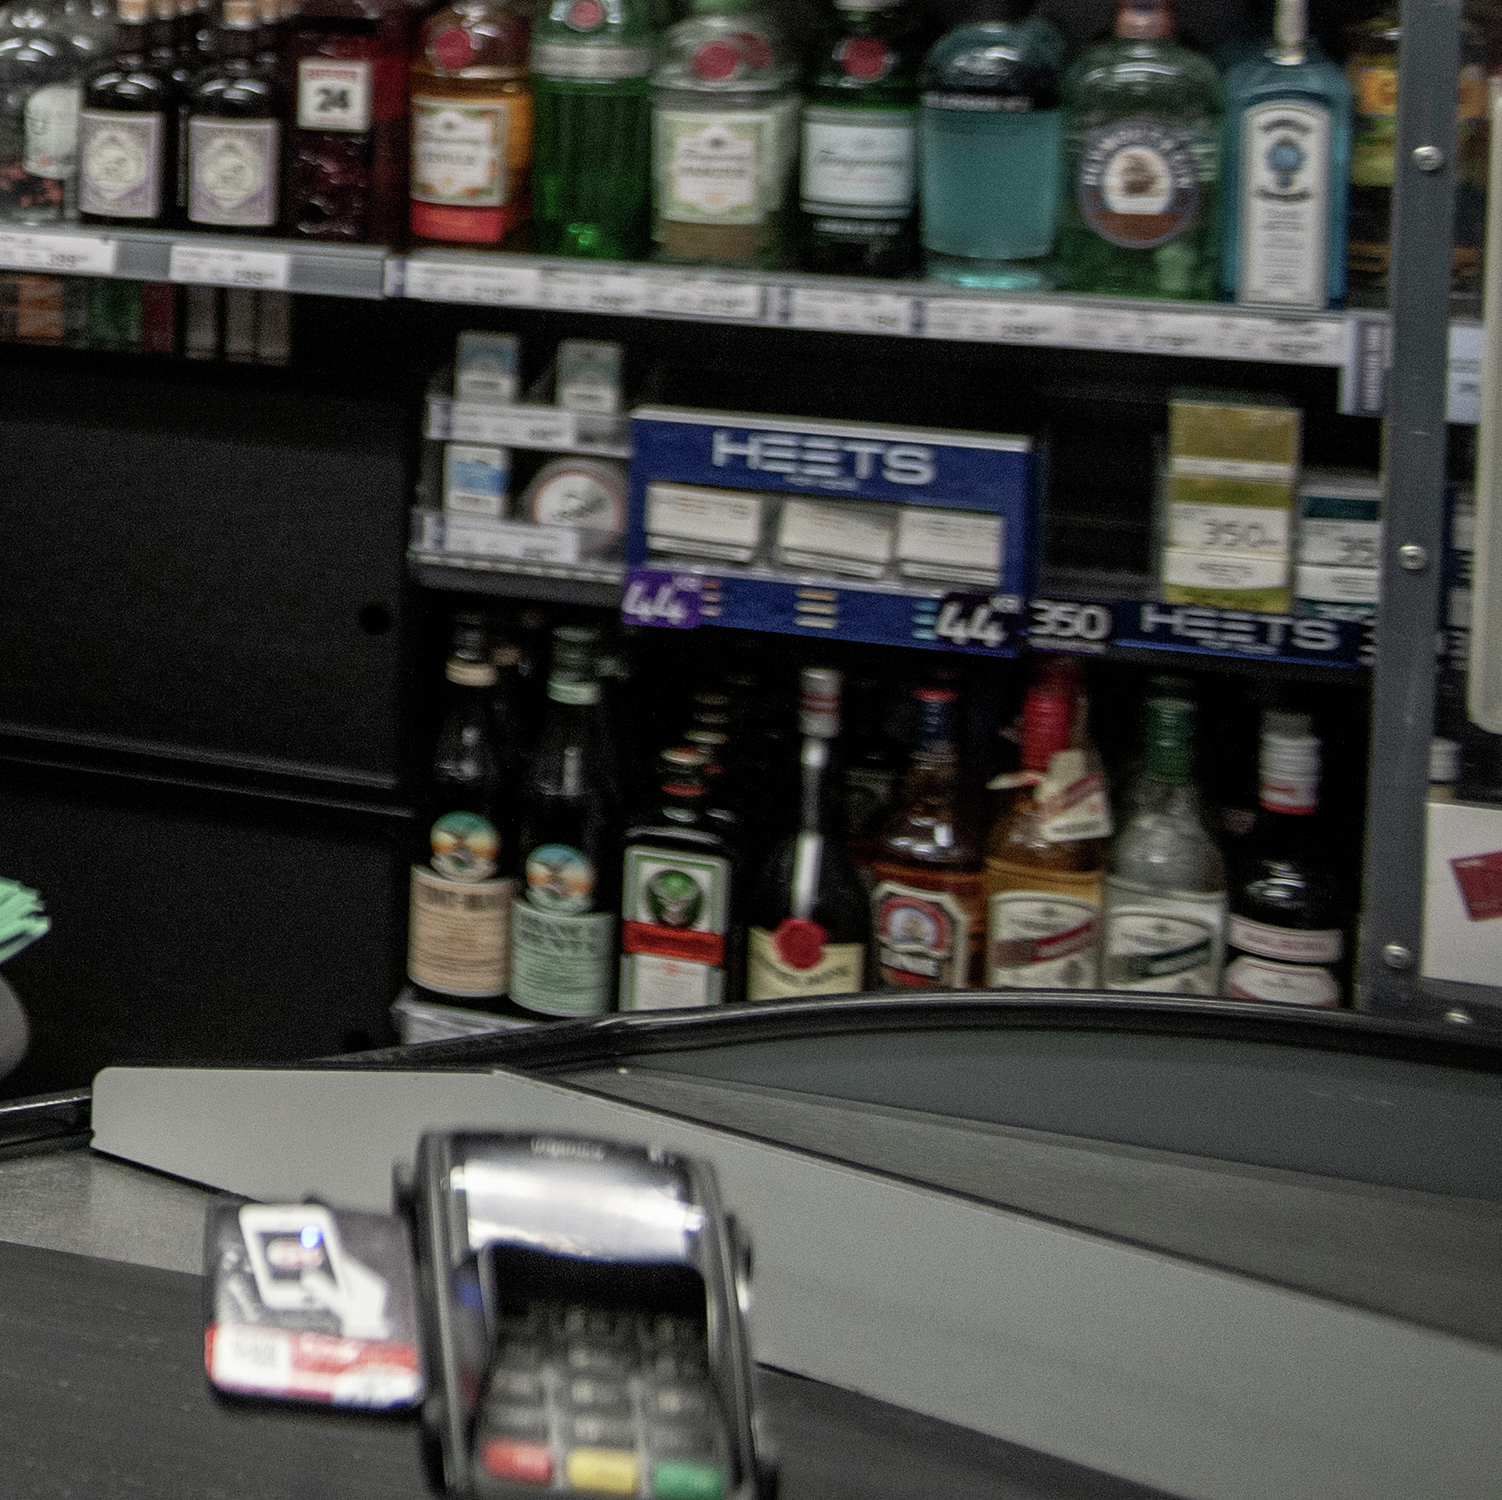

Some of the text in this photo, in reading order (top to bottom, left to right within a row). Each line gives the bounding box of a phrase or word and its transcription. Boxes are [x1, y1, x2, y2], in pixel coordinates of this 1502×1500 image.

[316, 87, 350, 112] 24
[711, 430, 937, 487] HEETS
[1027, 601, 1108, 643] 350
[1139, 603, 1340, 653] HEETS
